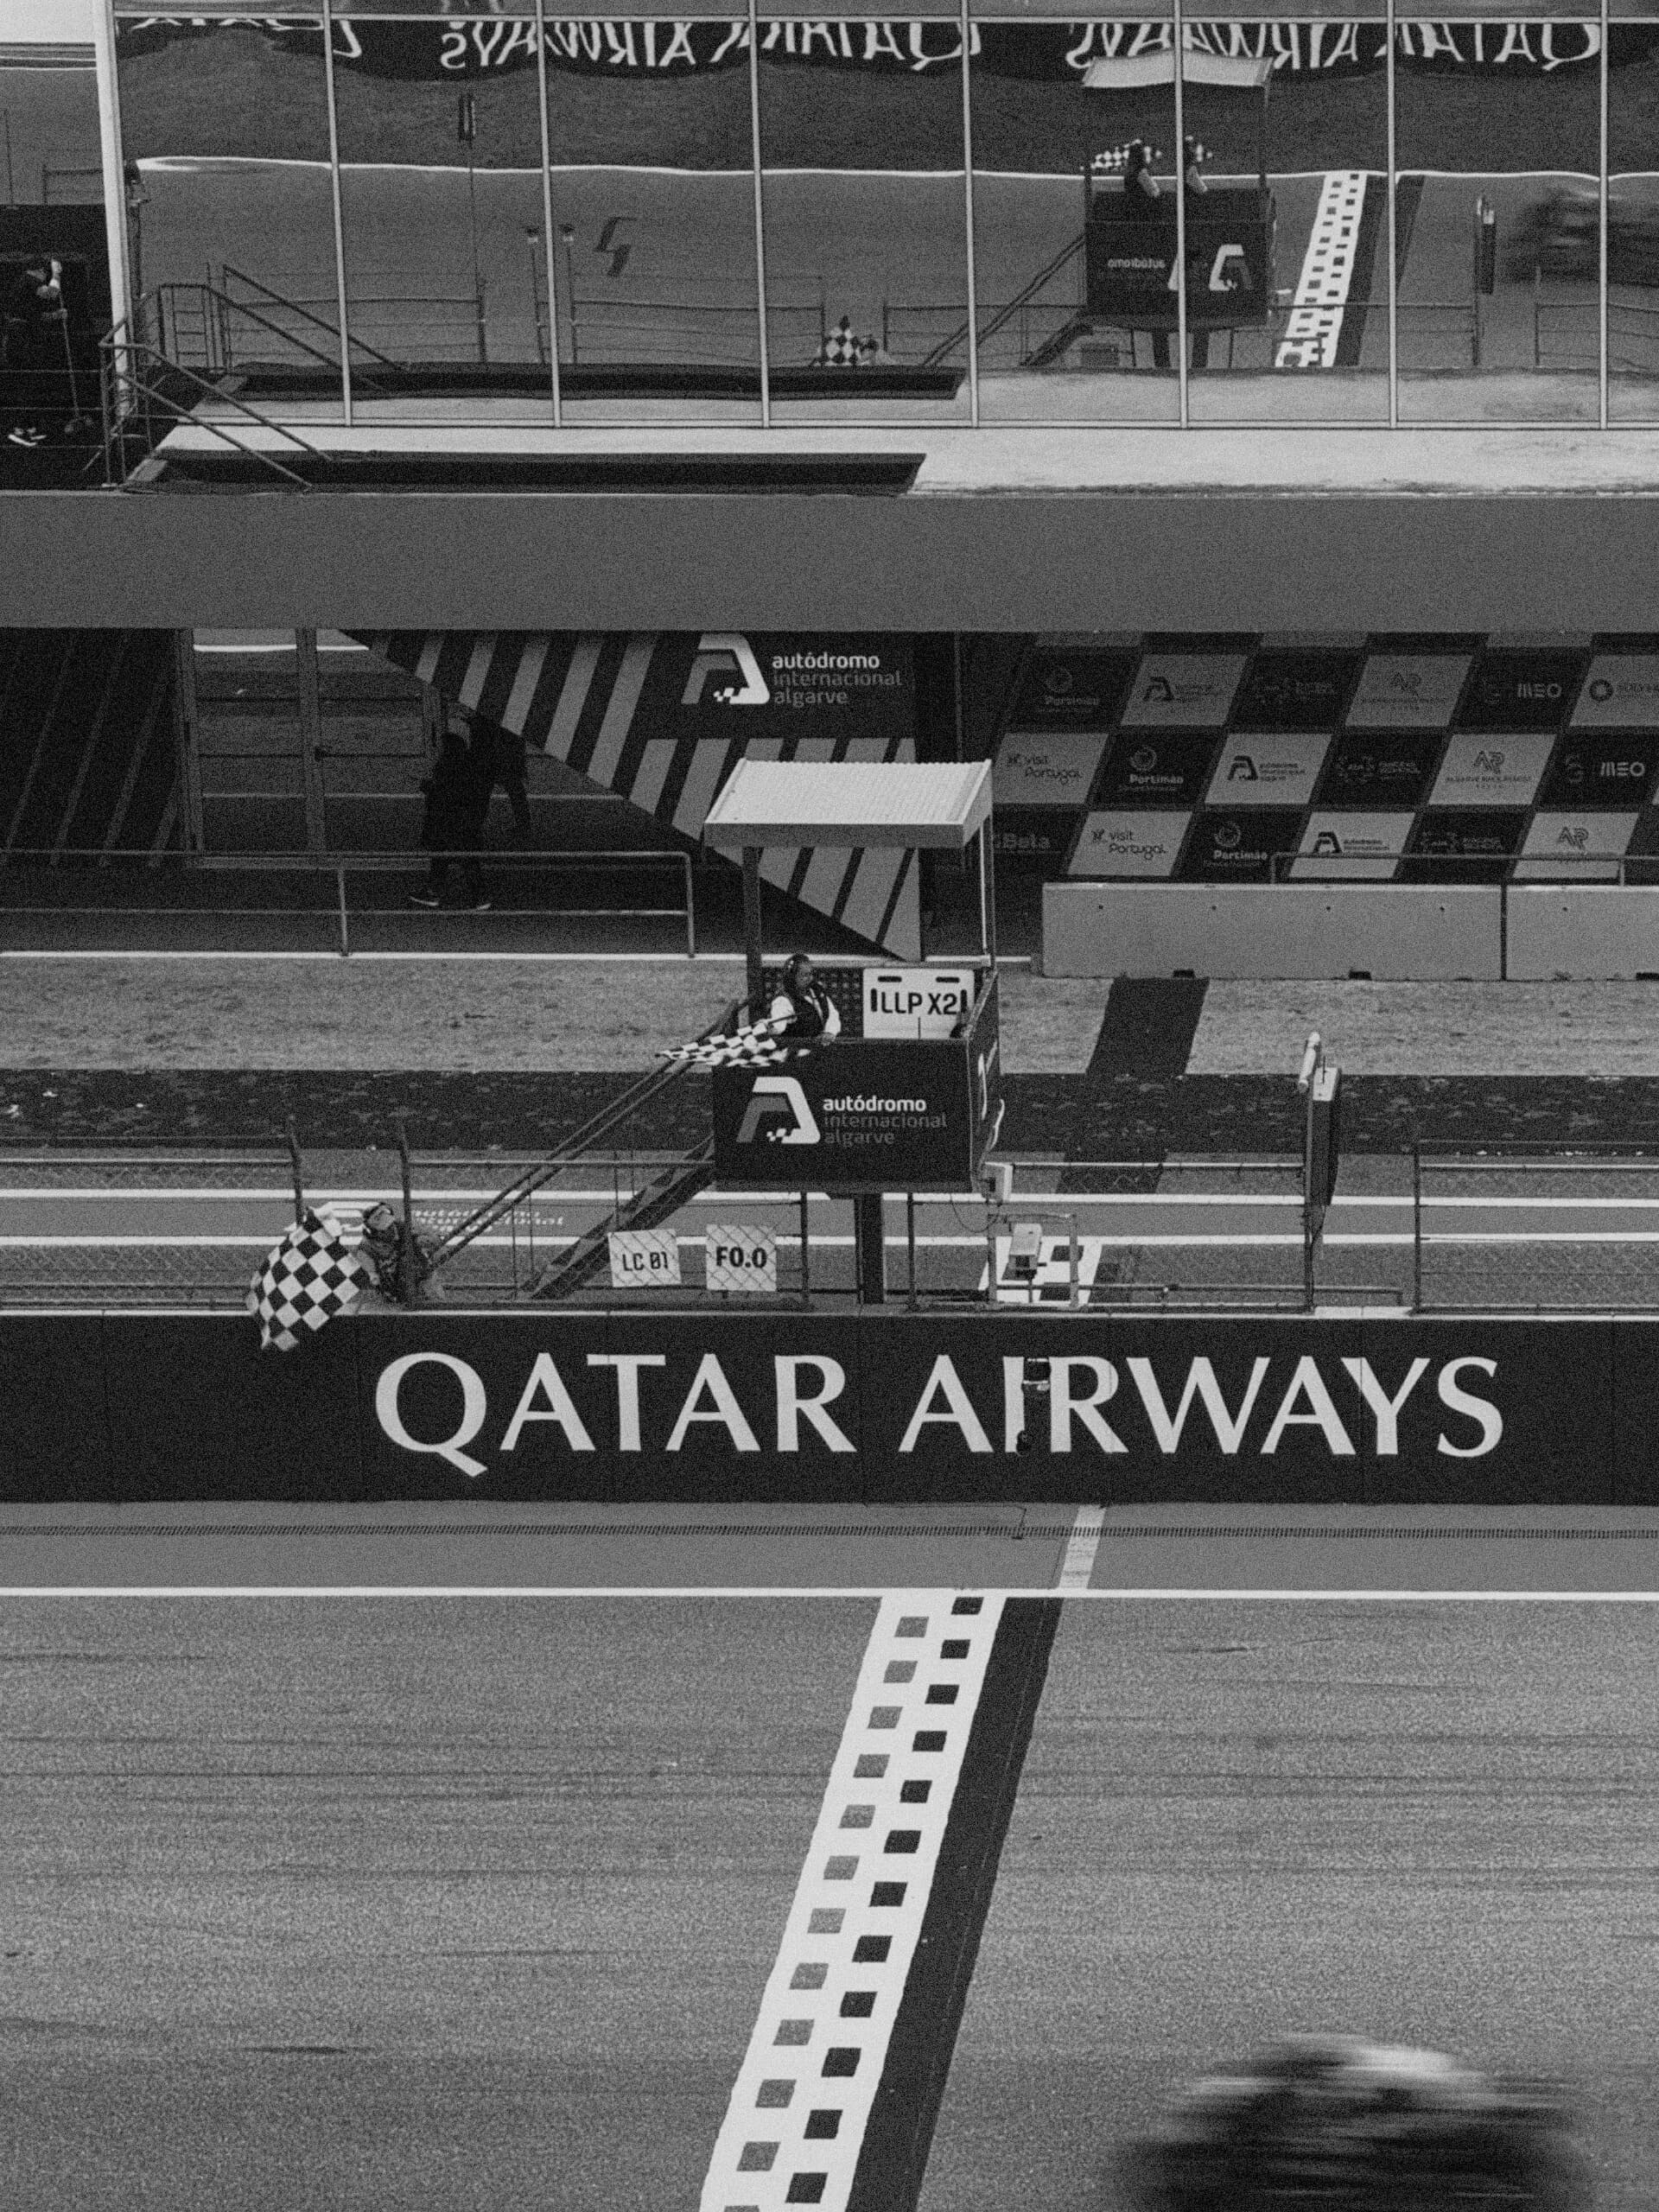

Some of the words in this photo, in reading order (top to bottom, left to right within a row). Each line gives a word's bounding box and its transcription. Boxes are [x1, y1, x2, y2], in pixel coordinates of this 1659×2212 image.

[772, 652, 880, 669] autódromo
[773, 670, 901, 687] internacional
[773, 687, 849, 708] algarve
[1600, 761, 1645, 778] MEO
[1109, 830, 1134, 842] visit
[1109, 843, 1168, 861] Portugal
[823, 1095, 927, 1112] autódromo
[824, 1112, 947, 1128] internacional
[824, 1128, 895, 1147] algarve
[375, 1351, 858, 1478] QATAR
[897, 1353, 1504, 1458] AIRWAYS
